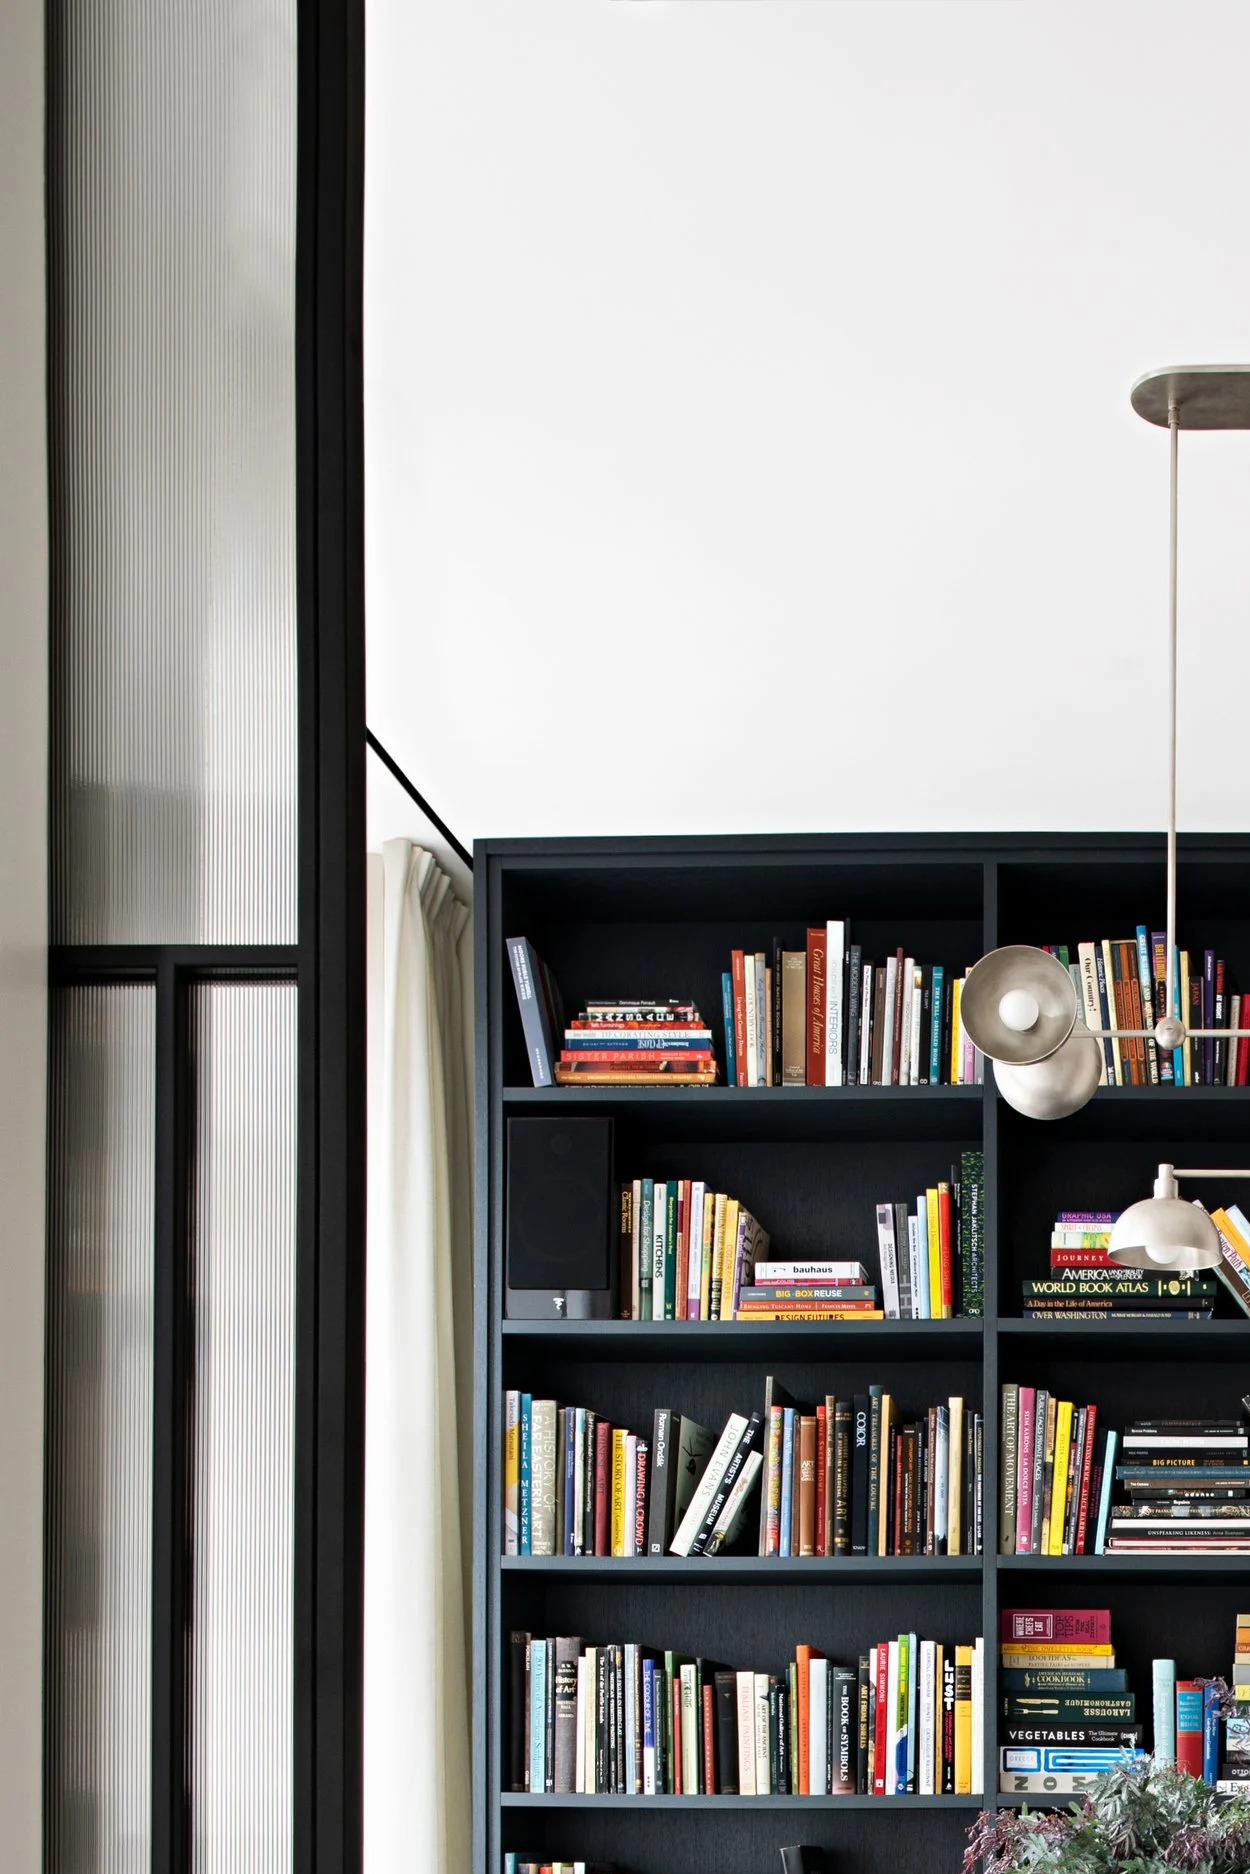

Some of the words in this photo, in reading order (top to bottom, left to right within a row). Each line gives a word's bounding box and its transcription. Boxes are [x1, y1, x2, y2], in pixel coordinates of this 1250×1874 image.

[813, 949, 824, 974] Great
[1085, 958, 1093, 973] Our
[813, 976, 824, 1005] Houses
[1086, 976, 1097, 1012] Country!
[1191, 983, 1200, 1005] JAPAN
[812, 1007, 824, 1016] of
[812, 1017, 823, 1054] America
[566, 1052, 608, 1061] SISTER
[613, 1052, 655, 1061] PARISH
[642, 1200, 650, 1224] Design
[641, 1237, 650, 1272] Shopping
[655, 1234, 663, 1278] KITCHENS
[1062, 1268, 1109, 1280] AMERICA
[1032, 1283, 1075, 1292] WORLD
[1079, 1283, 1113, 1292] BOOK
[1116, 1283, 1149, 1292] ATLAS
[1007, 1391, 1016, 1413] THE
[532, 1415, 541, 1440] FAR
[544, 1415, 553, 1425] A
[657, 1413, 666, 1441] Roman
[856, 1412, 866, 1447] COLOR
[1006, 1415, 1015, 1435] ART
[743, 1429, 755, 1444] THE
[1005, 1437, 1015, 1451] OF
[544, 1430, 553, 1487] HISTORY
[656, 1442, 665, 1467] Ondák
[532, 1446, 541, 1507] EASTERN
[636, 1453, 646, 1498] DRAWING
[725, 1452, 743, 1484] ARTIST'S
[1005, 1456, 1014, 1516] MOVEMENT
[544, 1495, 554, 1512] OF
[706, 1493, 725, 1525] MUSEUM
[532, 1510, 541, 1537] ART
[636, 1509, 644, 1545] CROWD
[1015, 1616, 1024, 1636] WHERE
[1025, 1617, 1033, 1635] CHEFS
[1035, 1621, 1043, 1631] EAT
[841, 1697, 849, 1725] BOOK
[860, 1700, 868, 1721] FROM
[1065, 1699, 1131, 1707] GASTRONOMIQUE
[1009, 1731, 1085, 1740] VEGETABLES
[840, 1734, 848, 1781] SYMBOLS
